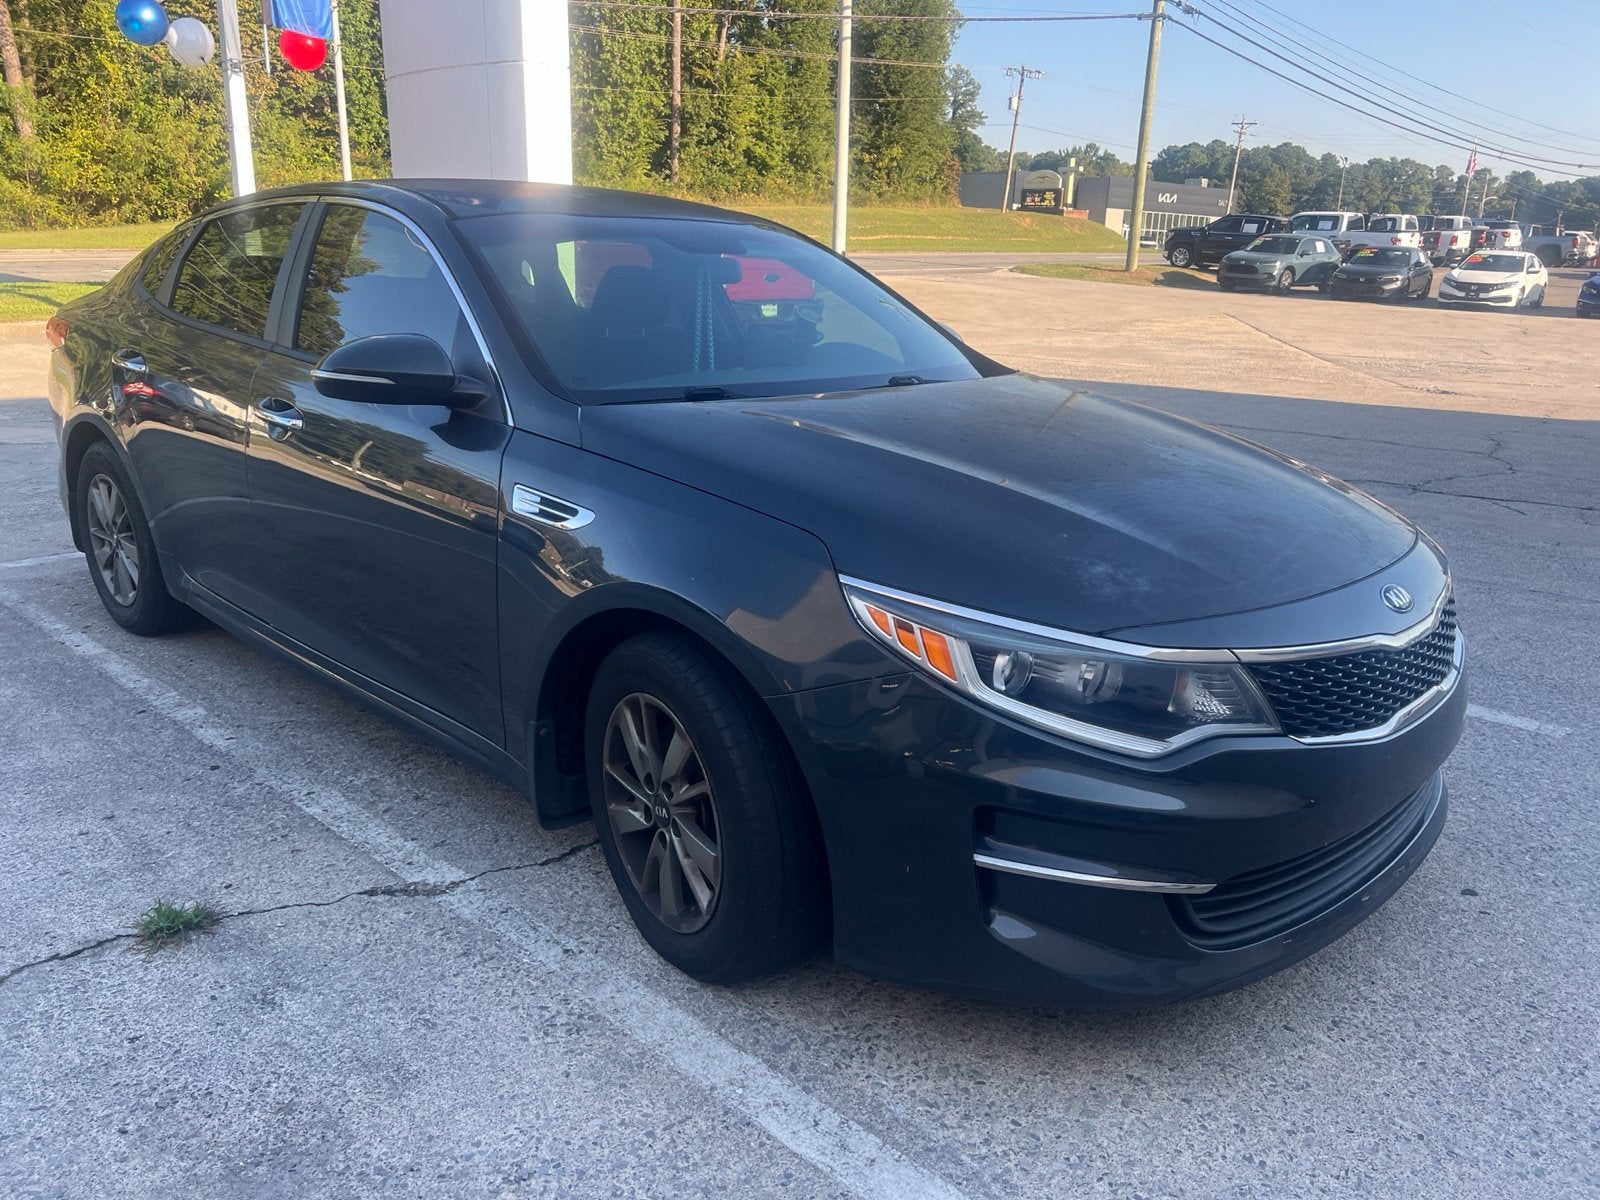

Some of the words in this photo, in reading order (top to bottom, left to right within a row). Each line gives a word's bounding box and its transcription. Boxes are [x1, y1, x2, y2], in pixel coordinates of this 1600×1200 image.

[1158, 192, 1178, 203] KIA
[1386, 586, 1411, 607] KIA
[655, 805, 669, 818] KIA
